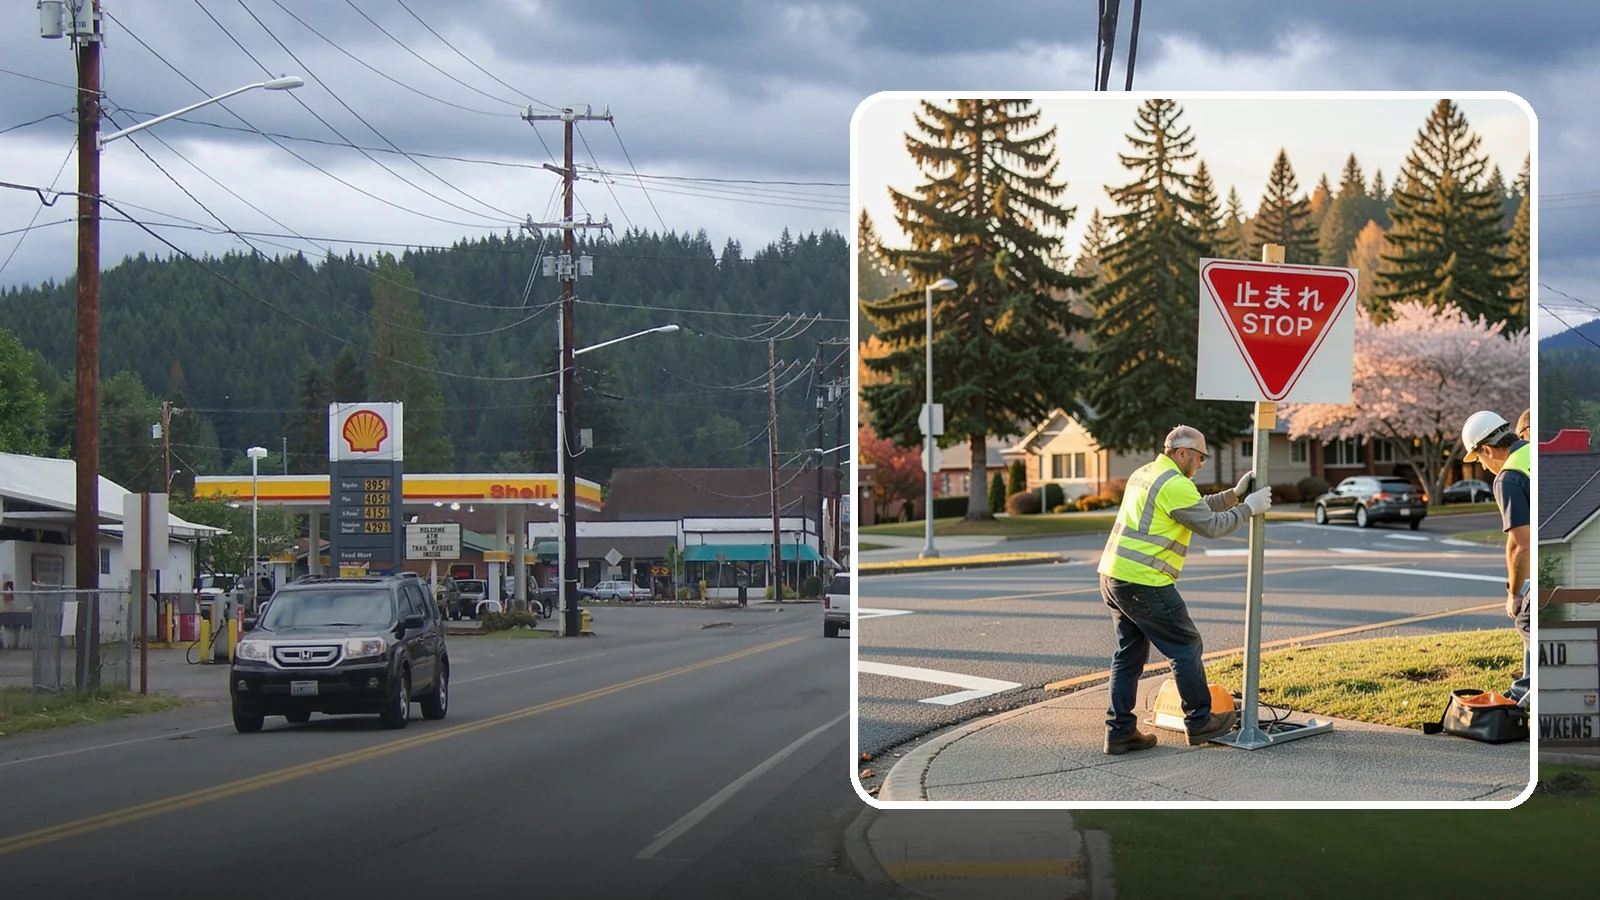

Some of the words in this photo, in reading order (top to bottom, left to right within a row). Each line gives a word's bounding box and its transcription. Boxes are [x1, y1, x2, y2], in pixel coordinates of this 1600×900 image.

[1233, 281, 1324, 312] 止まれ
[1242, 312, 1313, 337] STOP
[365, 480, 384, 490] 395
[490, 484, 547, 499] Shell
[365, 494, 384, 504] 405
[365, 508, 384, 518] 415
[365, 522, 384, 532] 429
